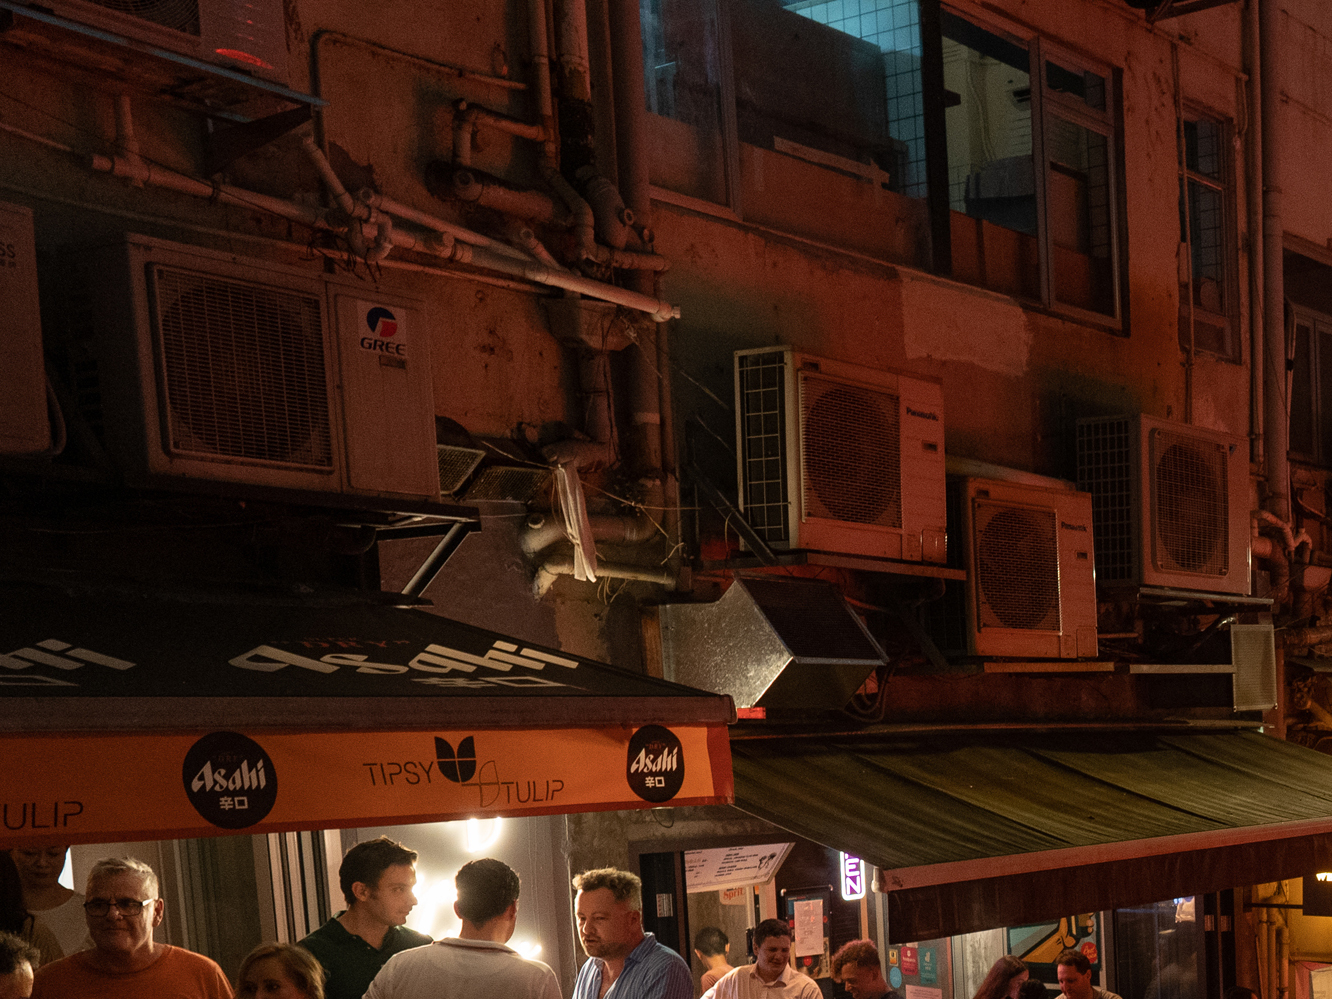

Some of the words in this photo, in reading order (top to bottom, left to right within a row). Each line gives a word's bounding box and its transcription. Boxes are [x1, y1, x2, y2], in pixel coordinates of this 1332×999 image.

[360, 337, 406, 355] GREE
[228, 640, 579, 674] Asahi
[630, 746, 679, 774] Asahi
[190, 758, 267, 793] Asahi
[363, 761, 434, 786] TIPSY
[644, 775, 666, 788] 辛口
[218, 795, 249, 811] 辛口
[501, 779, 565, 804] TULIP
[3, 800, 84, 830] ULIP
[844, 853, 861, 897] EN
